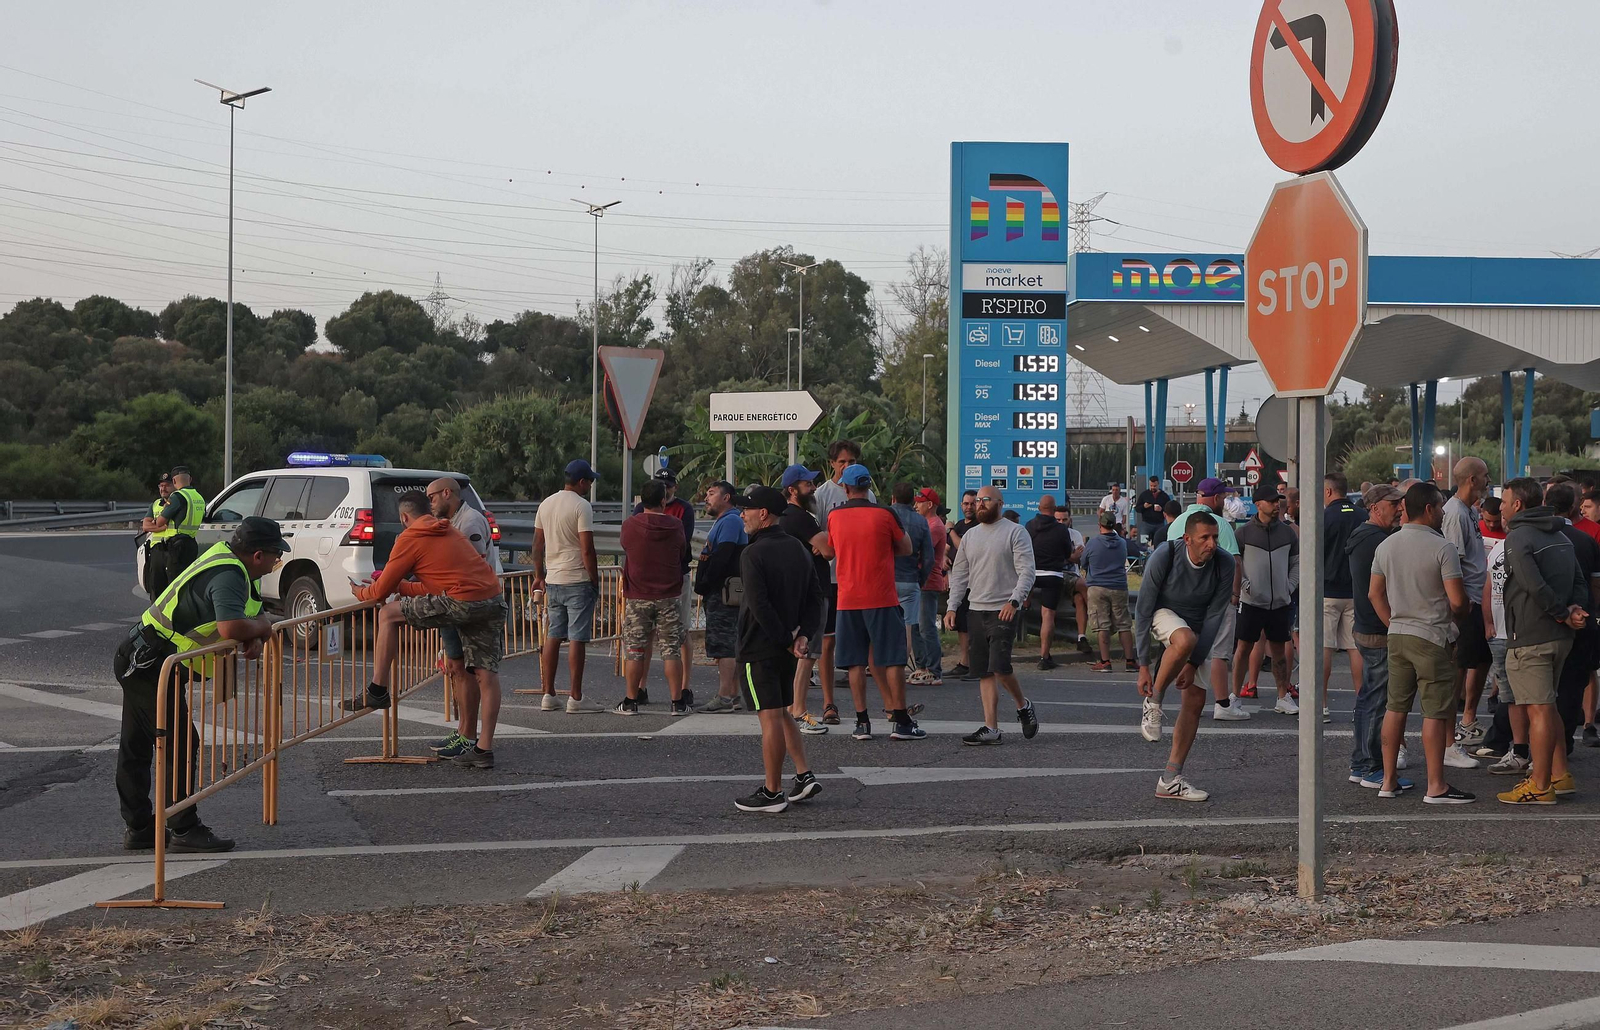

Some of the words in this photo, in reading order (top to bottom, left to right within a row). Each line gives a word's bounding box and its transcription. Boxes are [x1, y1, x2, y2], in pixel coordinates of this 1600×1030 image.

[985, 274, 1043, 287] market
[1112, 258, 1244, 296] moe
[1257, 258, 1348, 316] STOP
[981, 298, 1047, 314] R'SPIRO
[975, 359, 1000, 368] Diesel
[1019, 356, 1058, 372] 1.539
[975, 389, 989, 399] 95
[1018, 384, 1058, 400] 1.529
[746, 412, 798, 420] ENERGÉTICO
[974, 413, 1000, 421] Diesel
[1018, 412, 1058, 430] 1.599
[974, 443, 988, 452] 95
[1018, 441, 1058, 458] 1.599
[1248, 472, 1258, 480] 80
[394, 486, 428, 494] GUARD
[340, 507, 354, 519] 062
